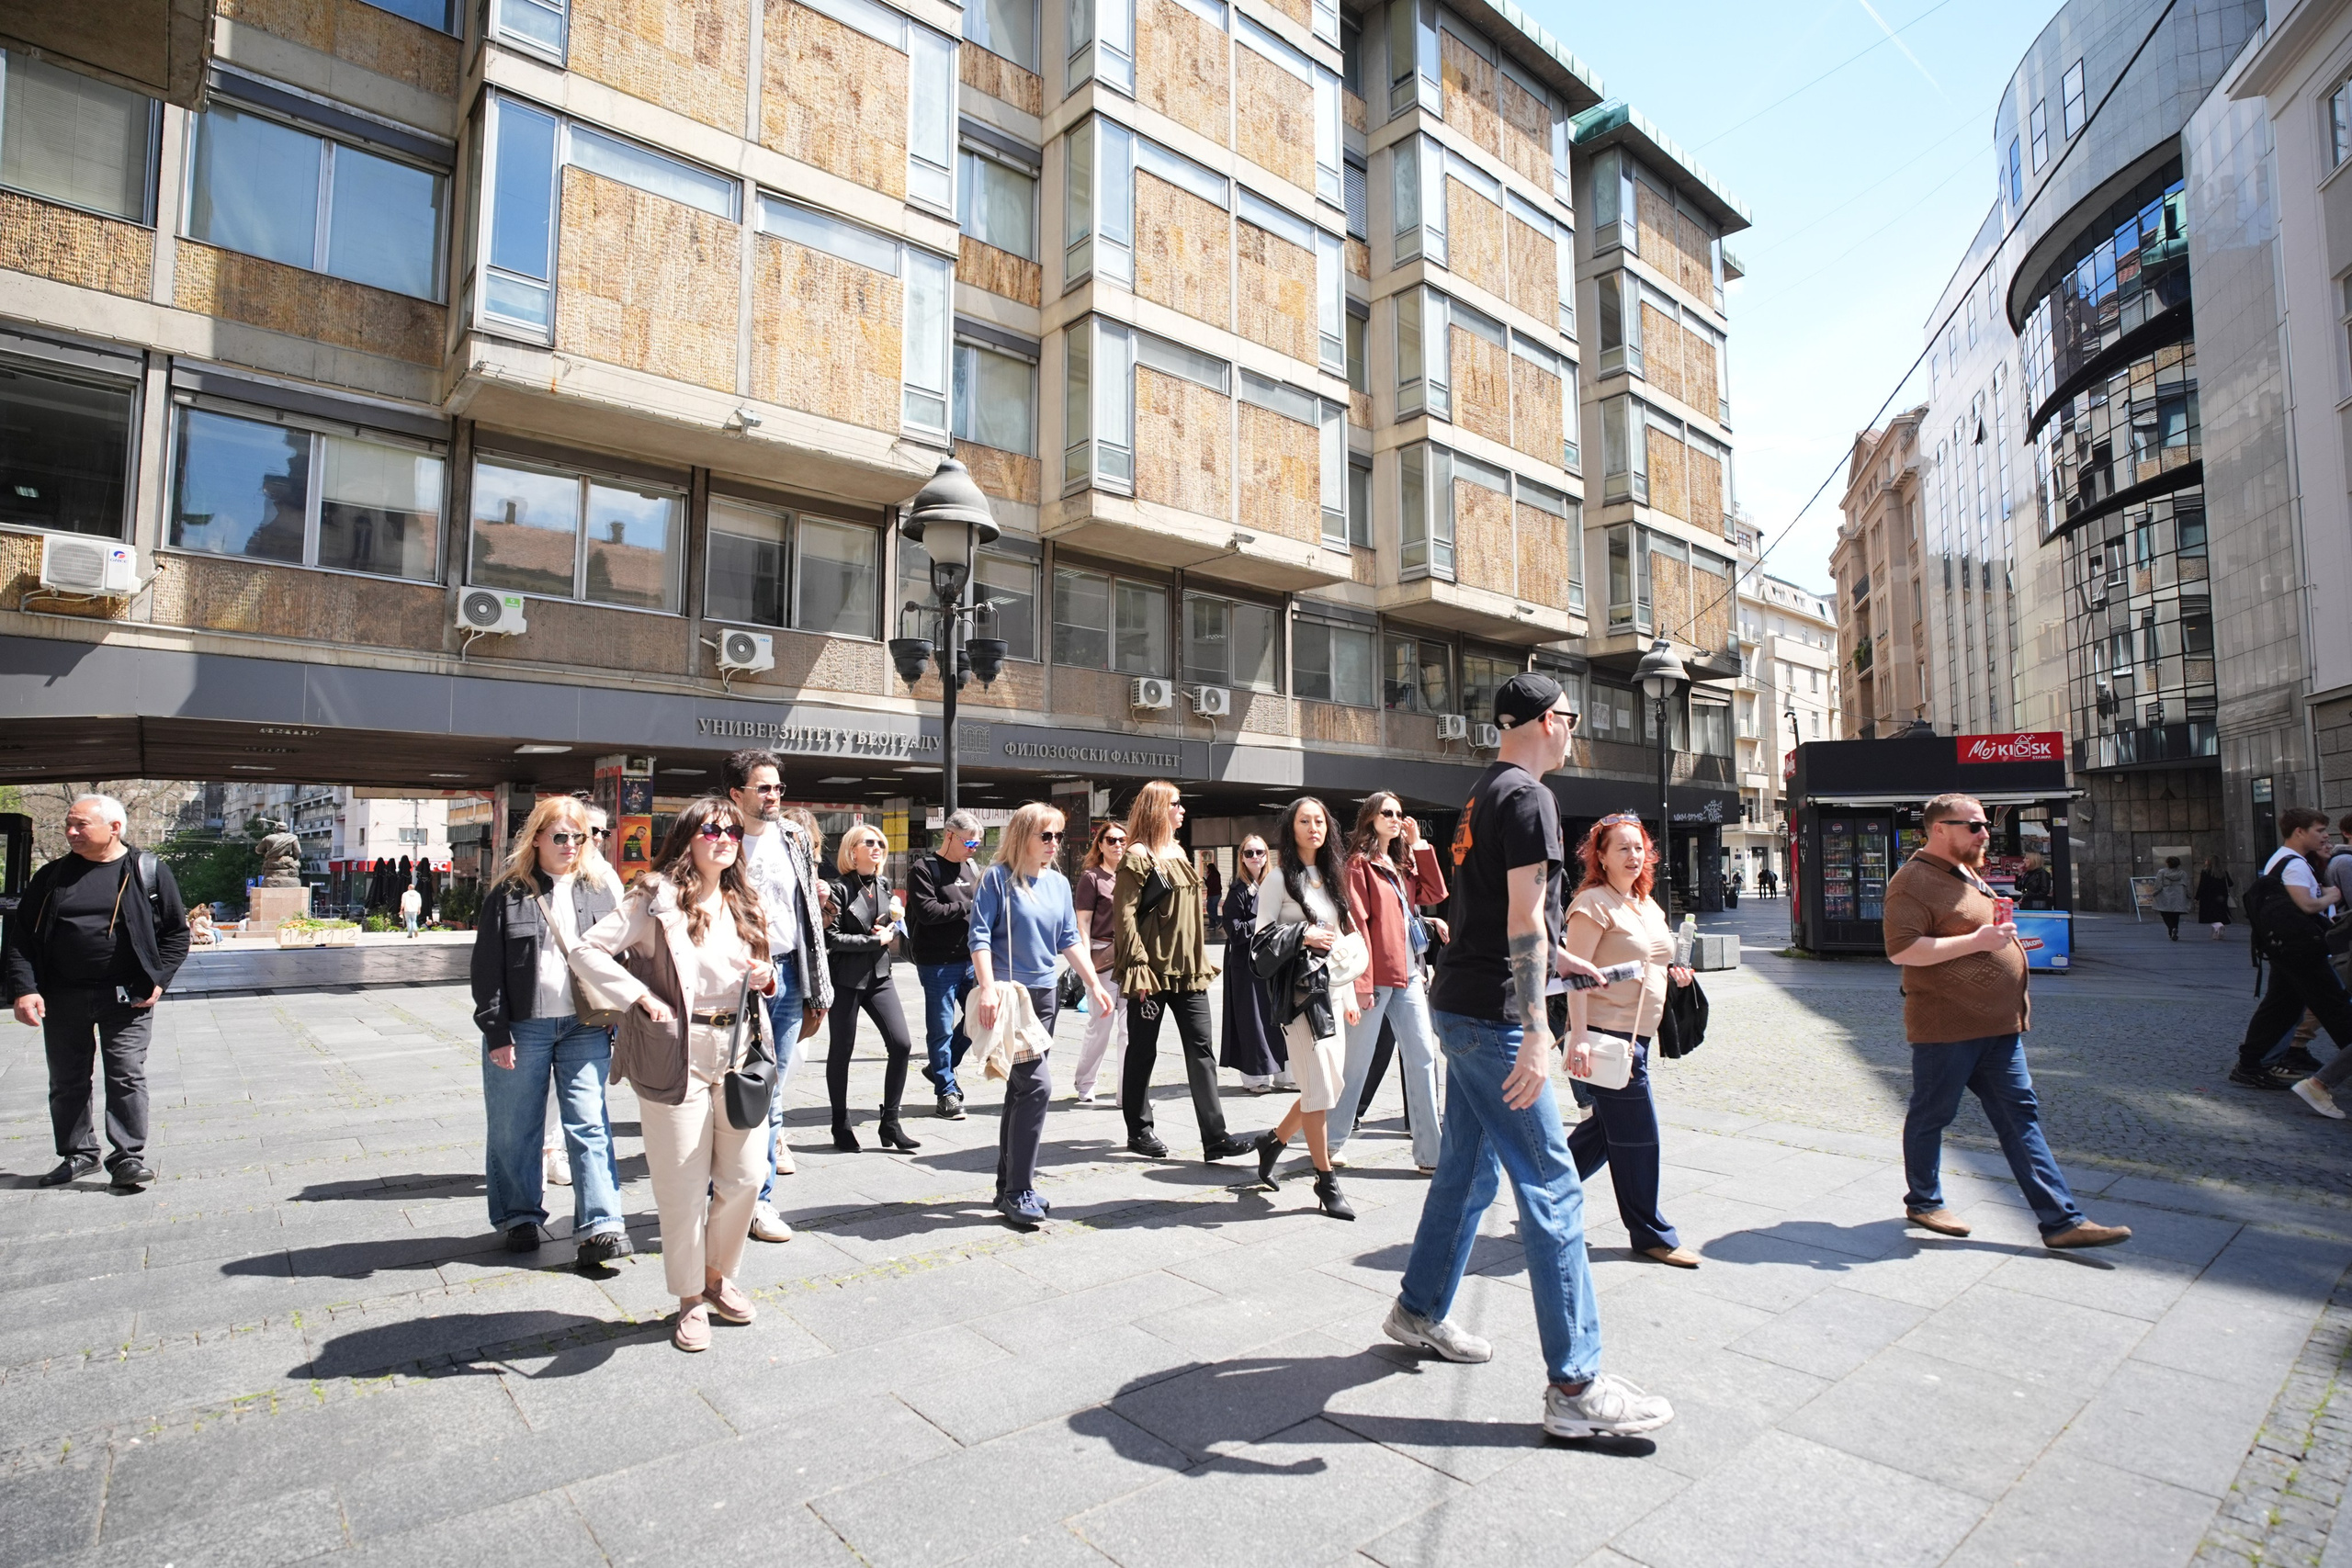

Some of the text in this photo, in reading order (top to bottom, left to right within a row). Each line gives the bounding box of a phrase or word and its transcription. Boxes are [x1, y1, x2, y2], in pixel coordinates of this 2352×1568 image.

[698, 717, 942, 750] УНИВЕРЗИТЕТ У БЕОГРАДУ
[1004, 741, 1180, 767] ФИЛОЗОФСКИ ФАКУЛТЕТ
[1968, 739, 2052, 760] Moj KIOSK
[429, 862, 447, 871] FC
